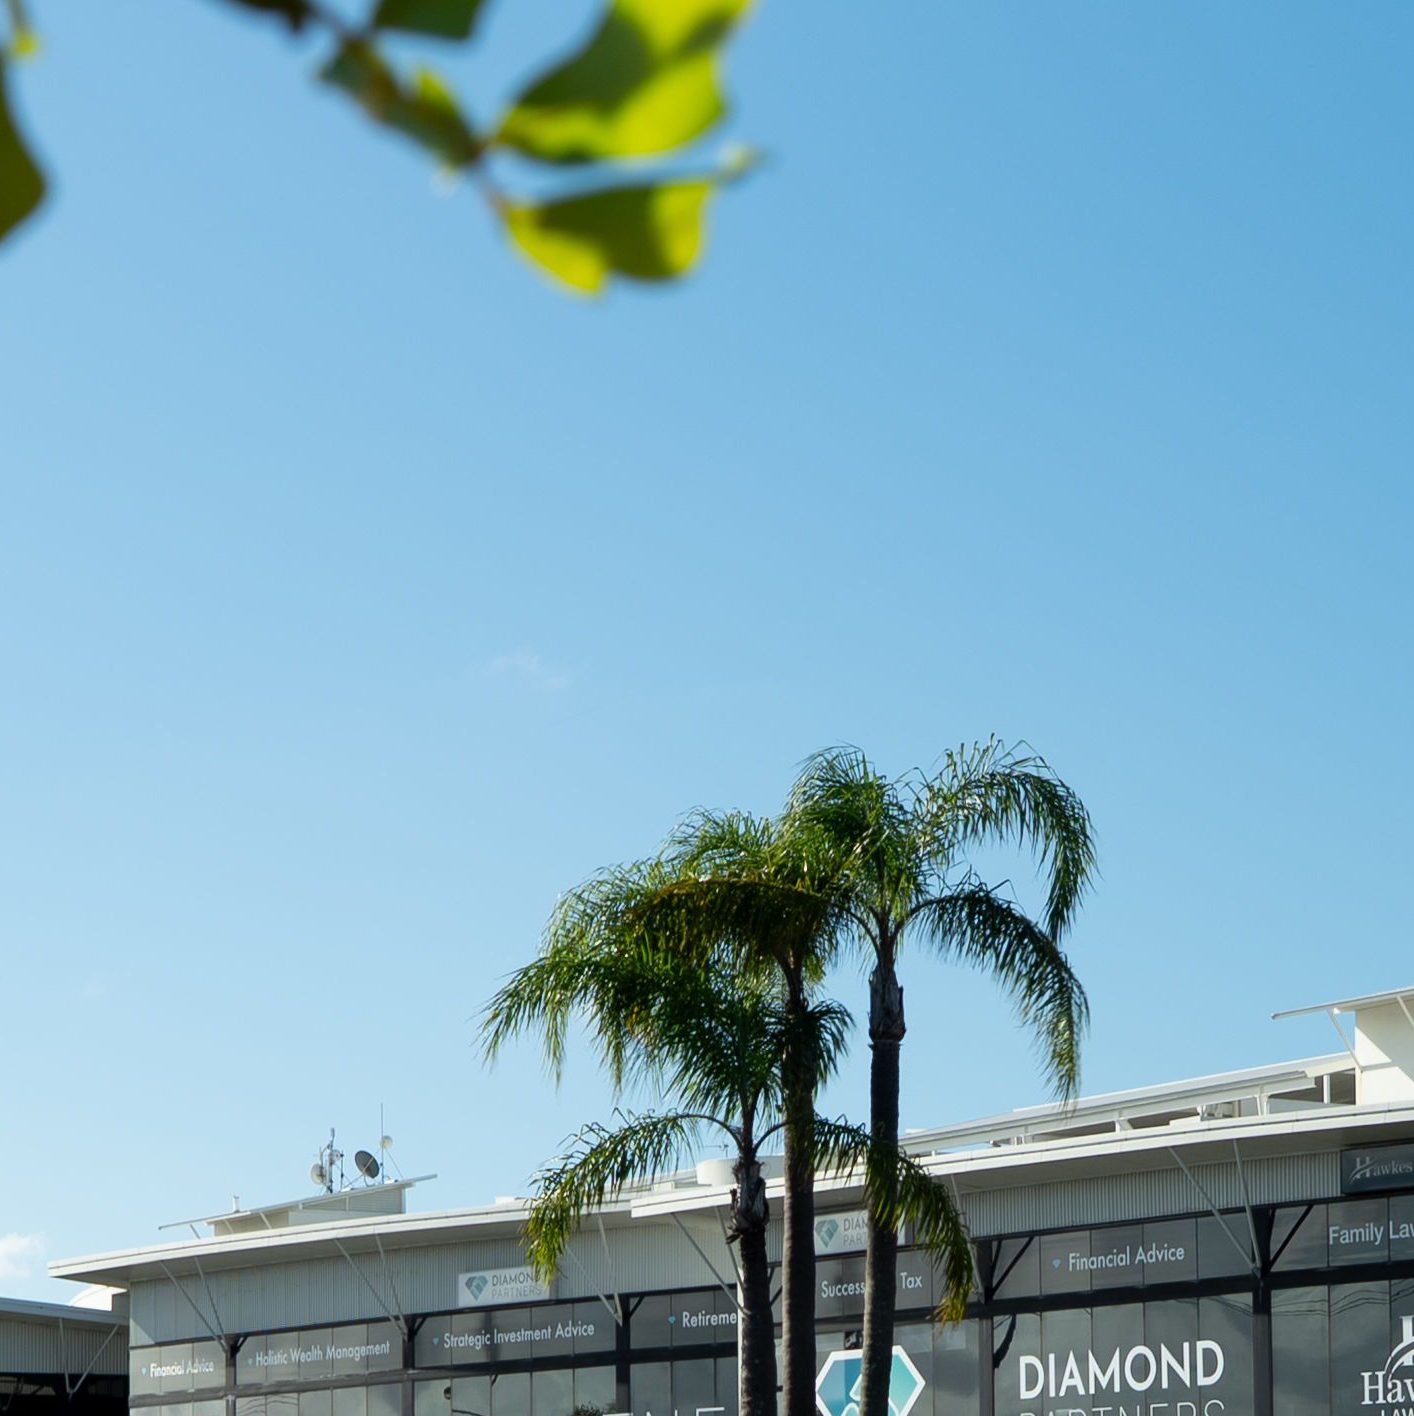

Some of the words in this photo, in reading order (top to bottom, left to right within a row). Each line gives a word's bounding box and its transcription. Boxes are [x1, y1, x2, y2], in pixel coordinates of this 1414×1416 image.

[1352, 1155, 1413, 1181] Hawkes
[1328, 1222, 1384, 1246] Family
[1068, 1246, 1131, 1271] Financial
[1135, 1242, 1186, 1265] Advice
[491, 1284, 543, 1300] PARTNERS
[821, 1280, 866, 1298] Success
[900, 1271, 922, 1290] Tax
[681, 1311, 737, 1329] Retireme
[443, 1329, 491, 1351] Strategic
[493, 1325, 552, 1346] Investment
[554, 1320, 595, 1339] Advice
[255, 1350, 288, 1368] Holistic
[290, 1344, 323, 1363] Wealth
[325, 1340, 391, 1363] Management
[149, 1359, 185, 1378] Financial
[186, 1358, 215, 1375] Advice
[1018, 1339, 1226, 1400] DIAMOND
